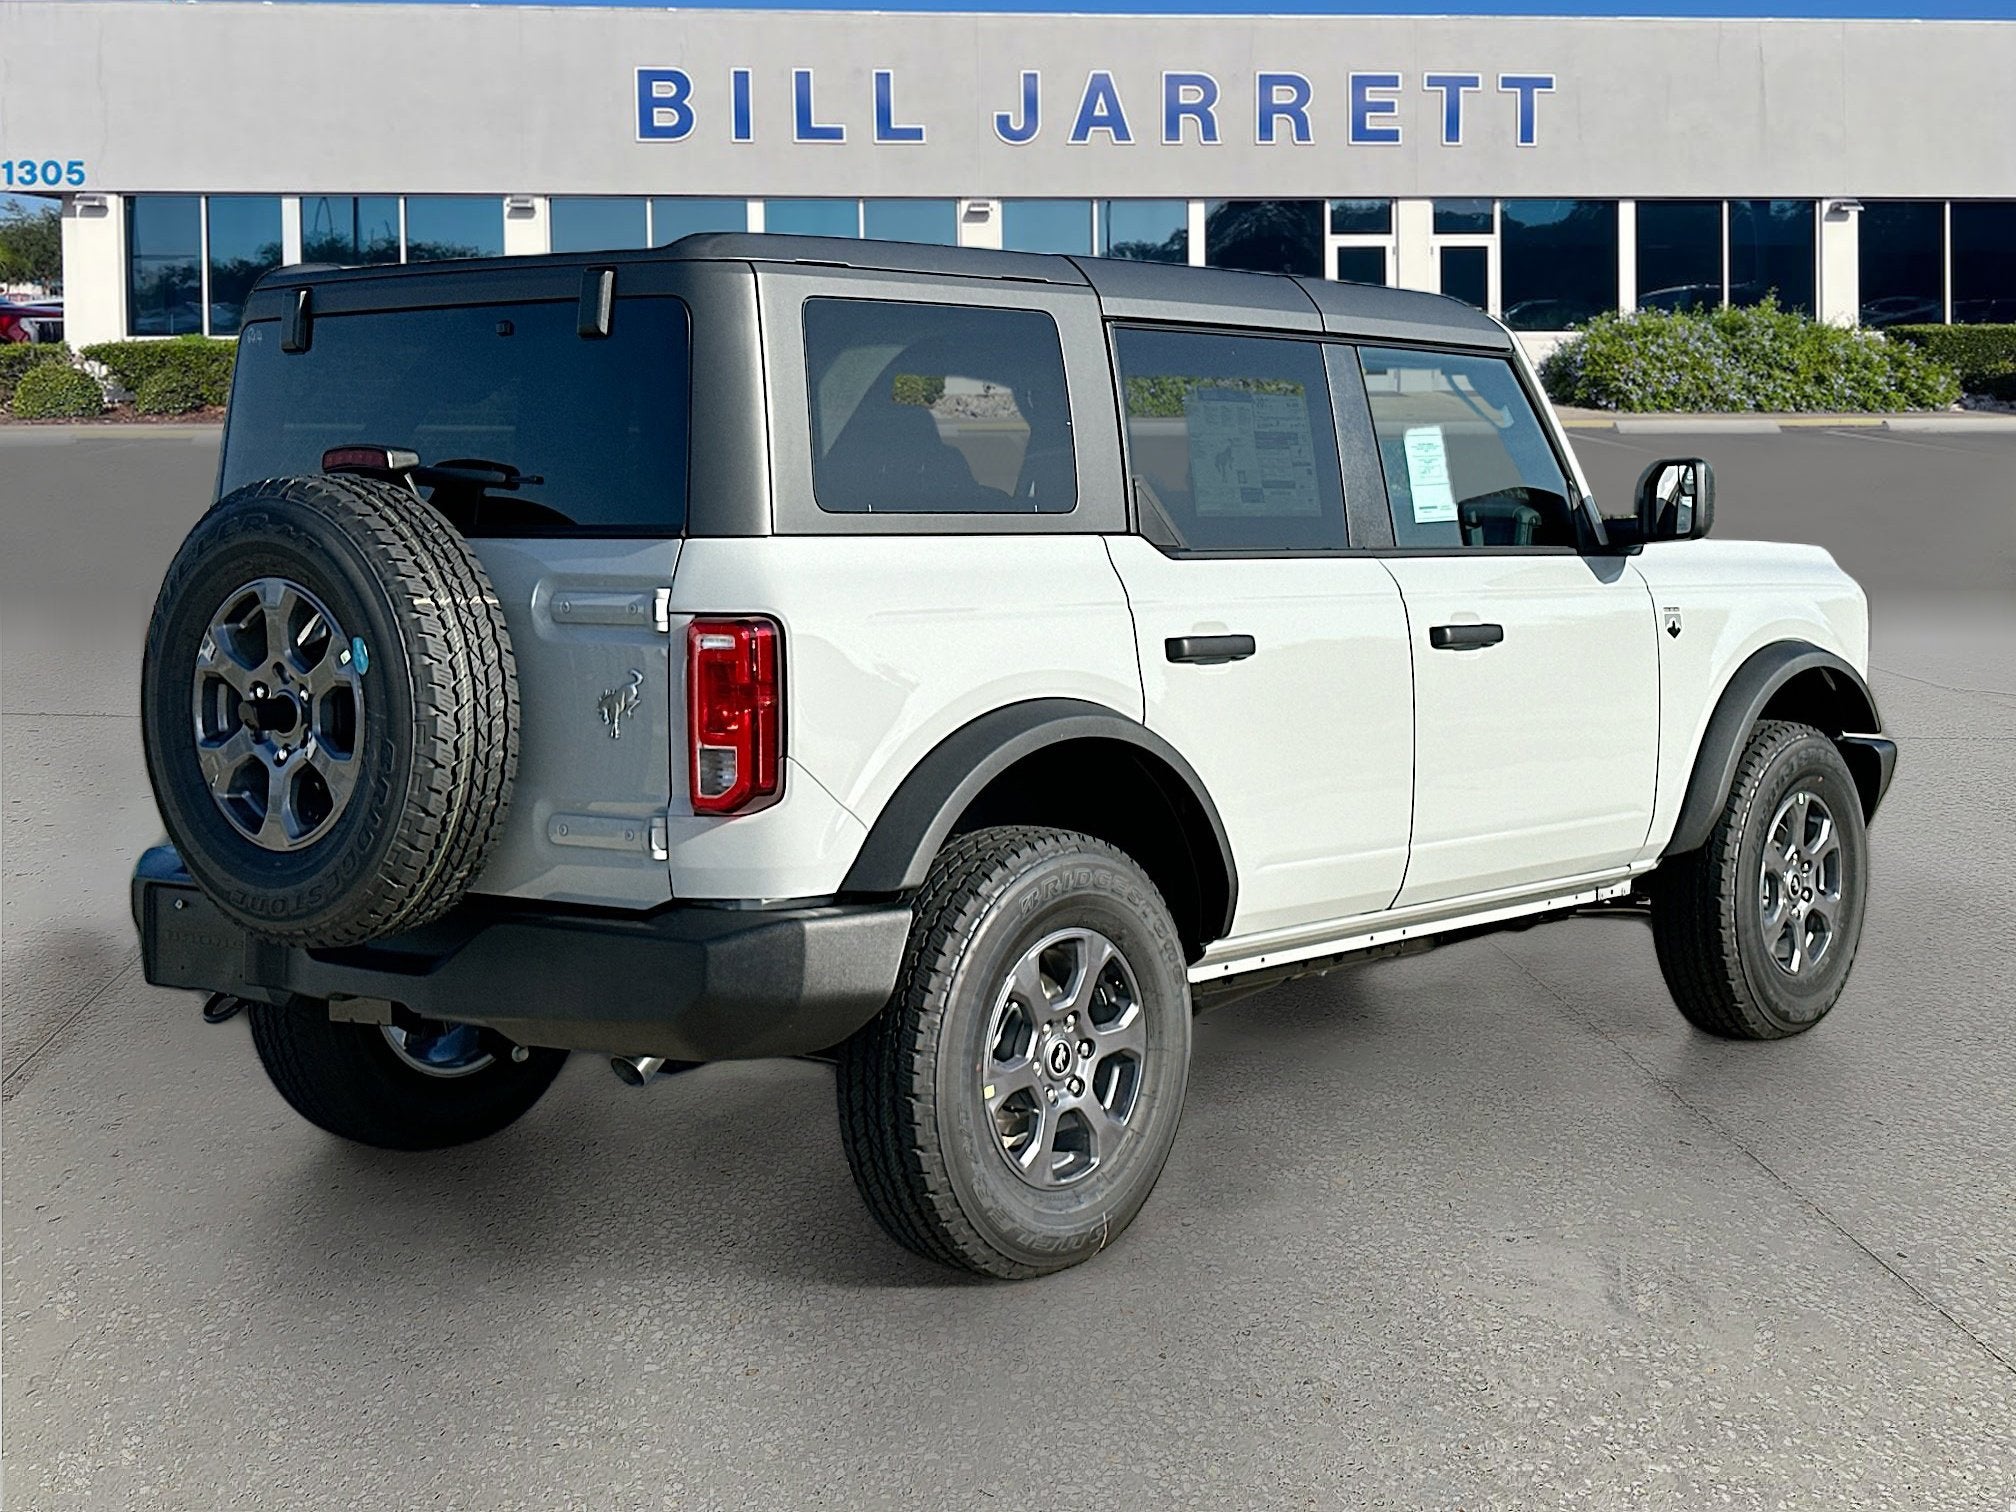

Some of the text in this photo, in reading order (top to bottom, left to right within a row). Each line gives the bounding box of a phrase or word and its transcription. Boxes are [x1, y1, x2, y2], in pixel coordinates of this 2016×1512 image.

[634, 66, 1556, 146] BILL JARRETT
[1, 159, 86, 186] 1305
[229, 738, 395, 917] BRIDGESTONE
[1018, 867, 1185, 987] BRIDGESTONE
